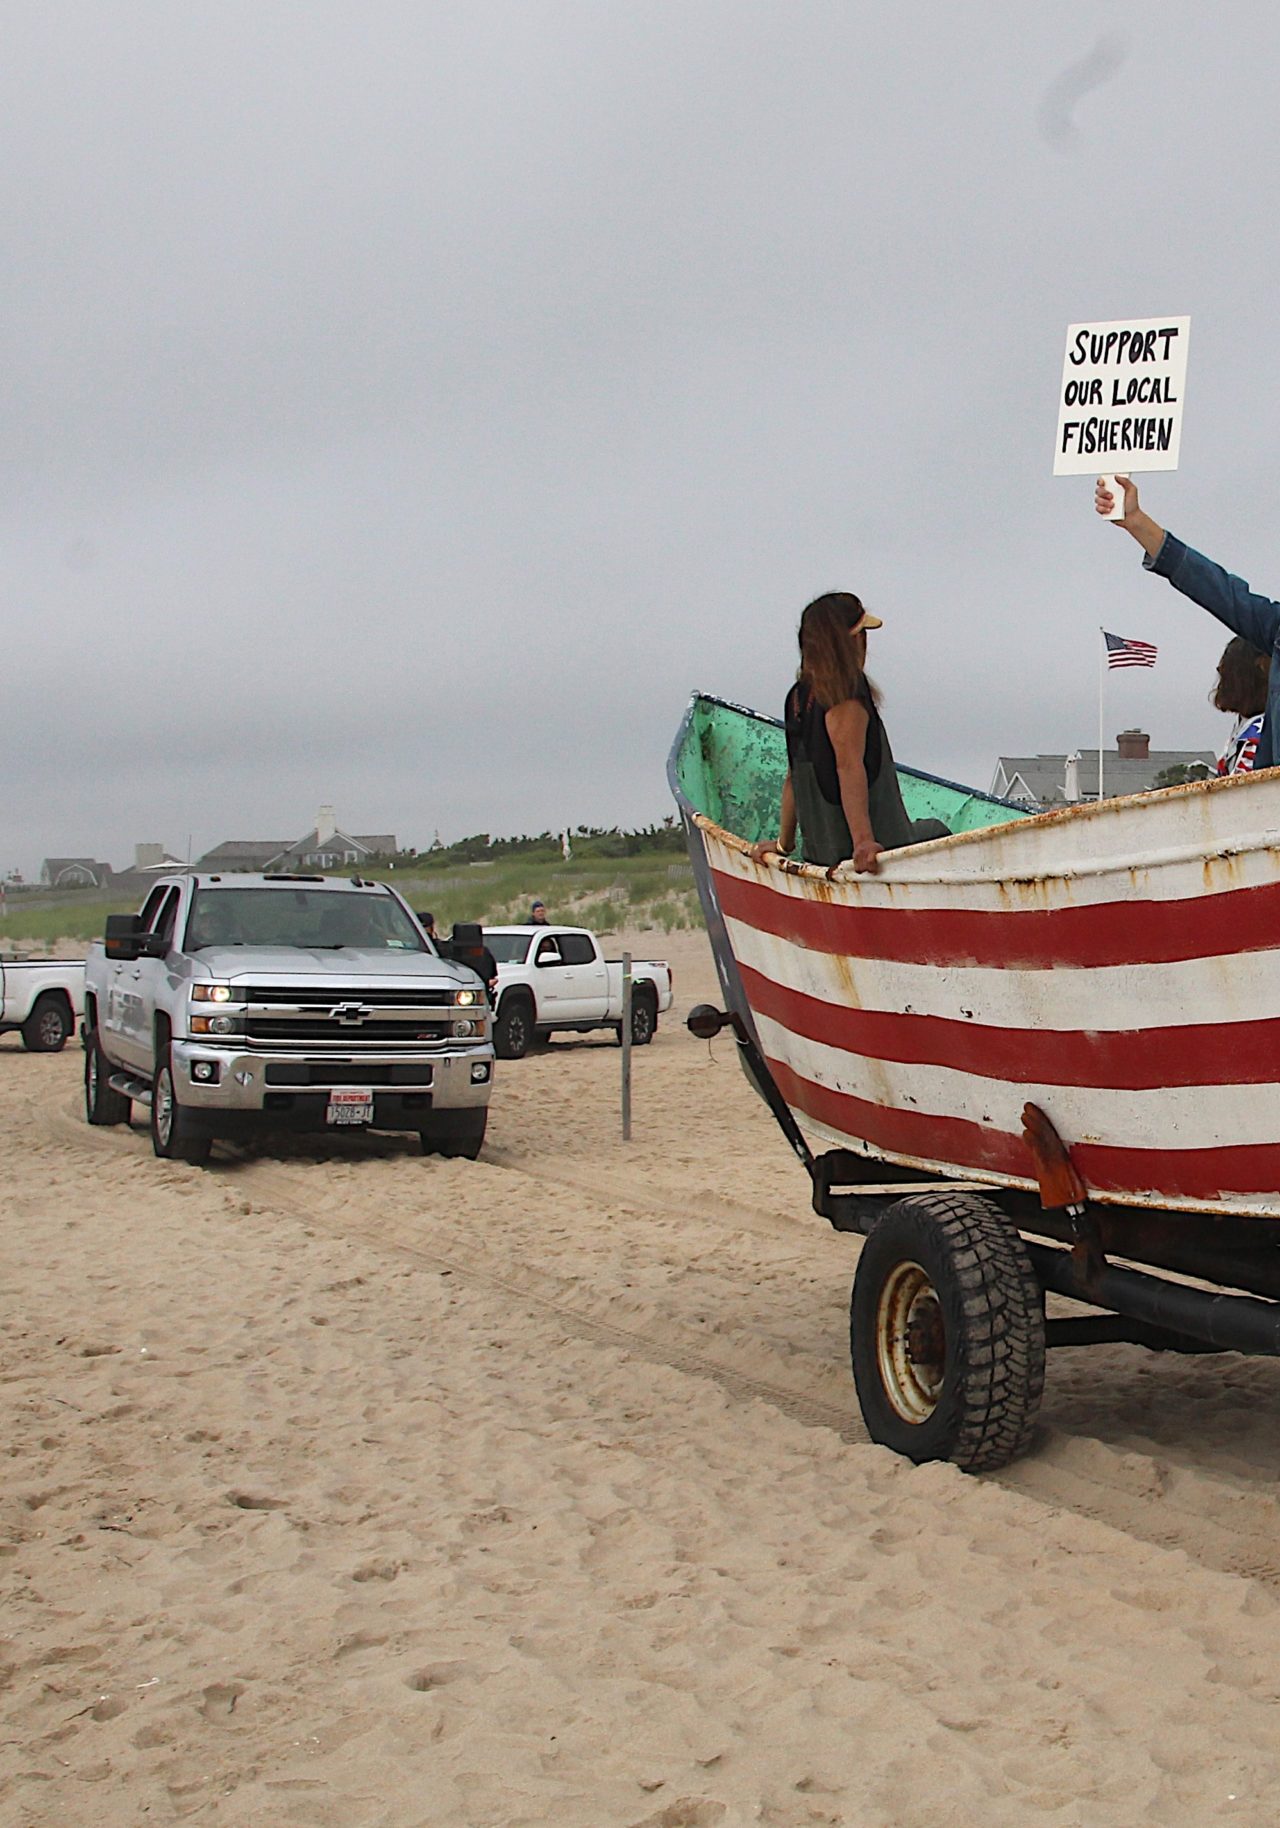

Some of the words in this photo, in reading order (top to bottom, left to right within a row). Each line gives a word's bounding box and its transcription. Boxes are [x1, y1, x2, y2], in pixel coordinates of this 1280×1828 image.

[1068, 327, 1179, 366] SUPPORT
[1064, 378, 1103, 407] OUR
[1111, 376, 1177, 406] LOCAL
[1062, 416, 1174, 454] FISHERMEN
